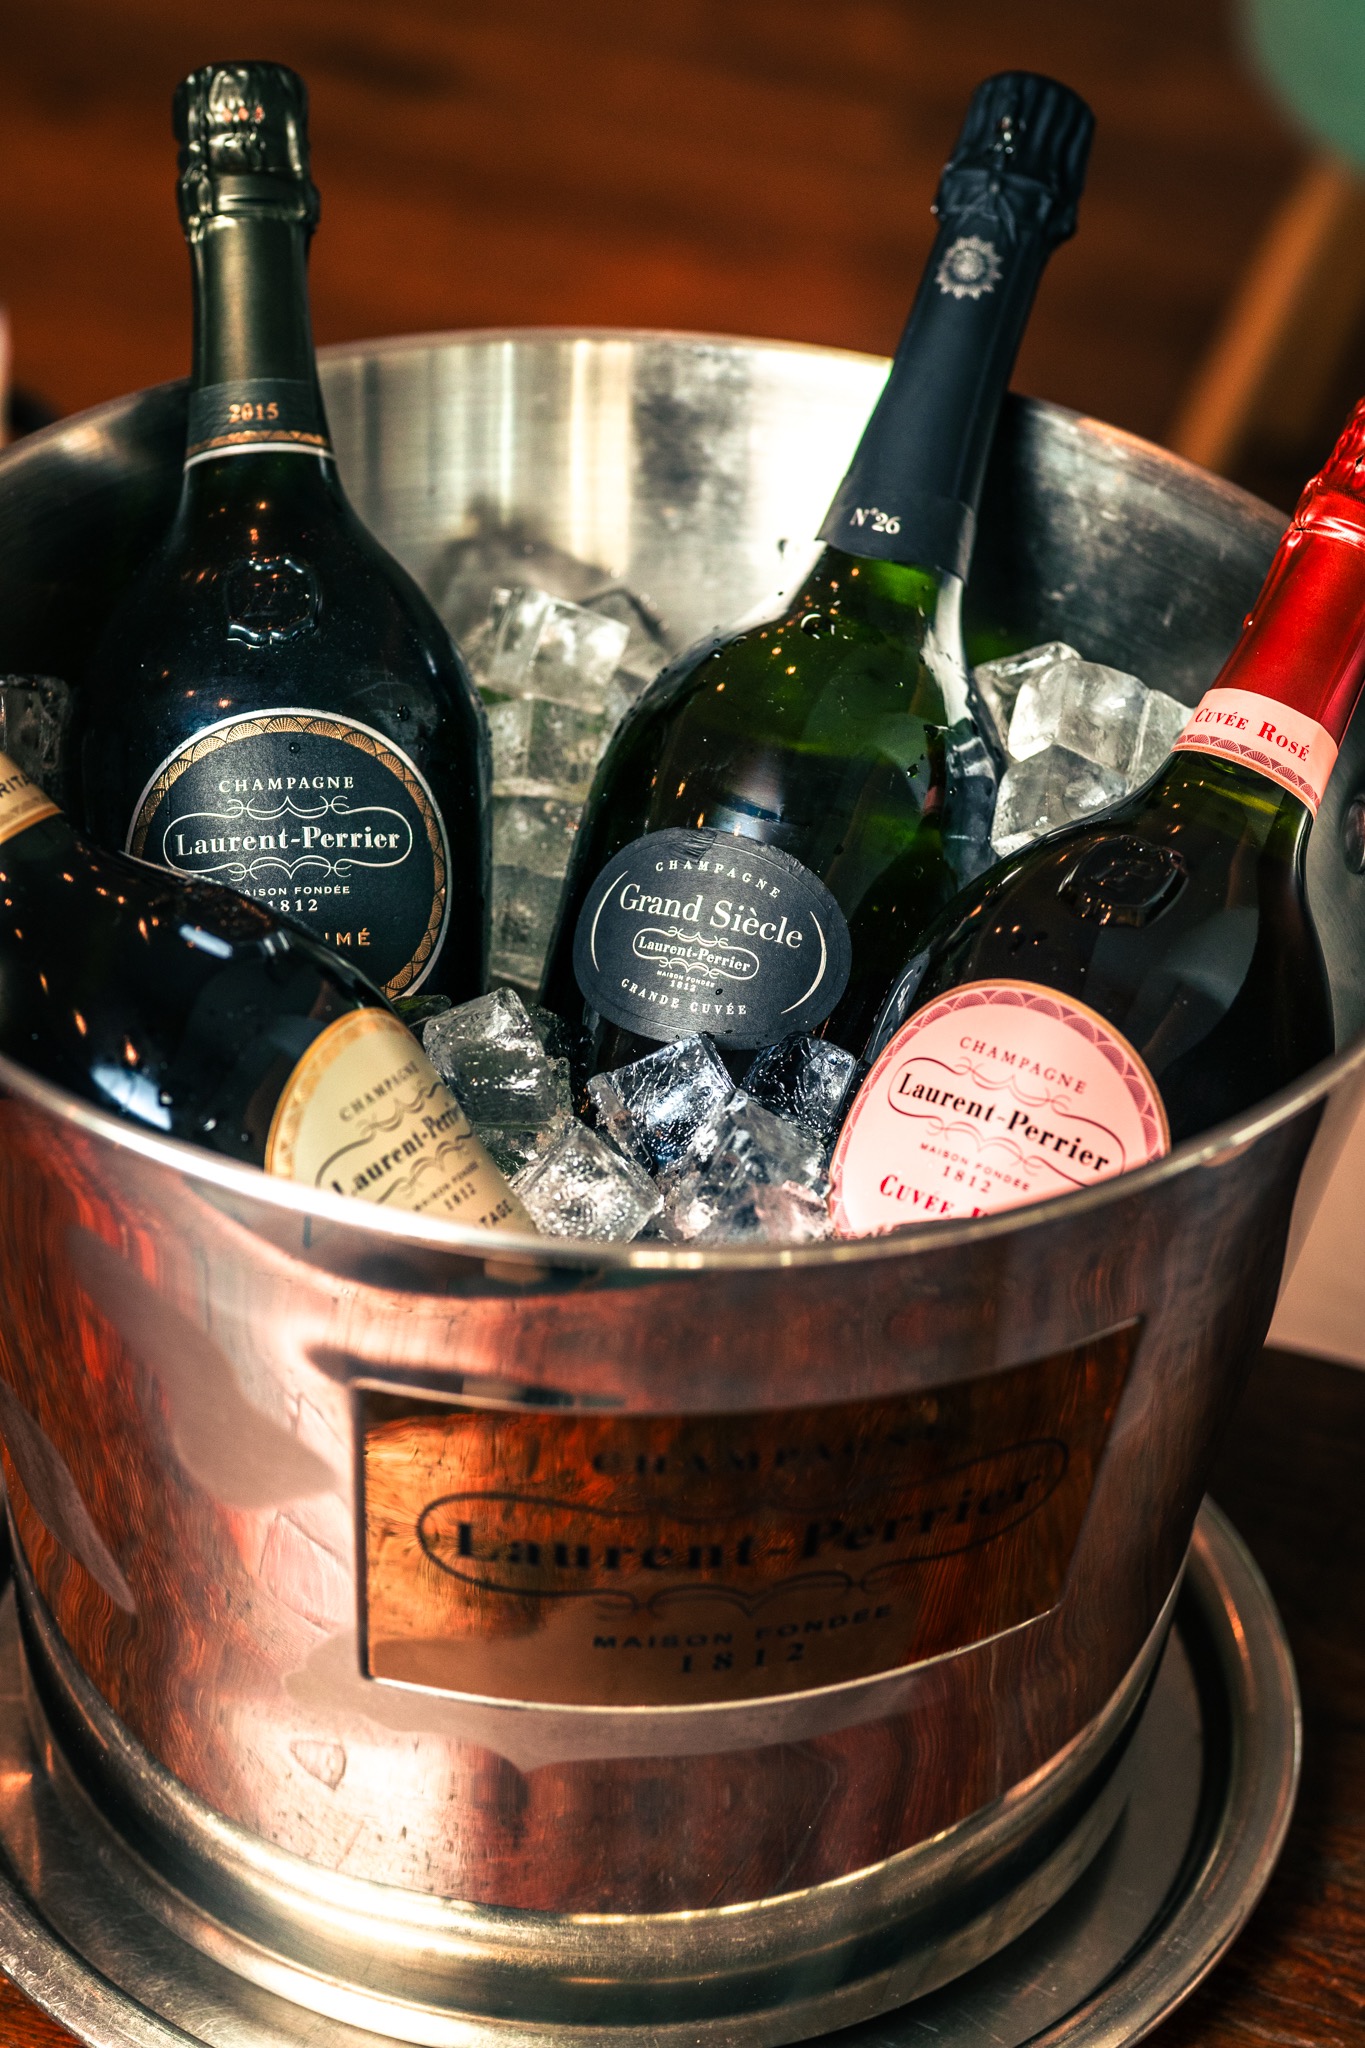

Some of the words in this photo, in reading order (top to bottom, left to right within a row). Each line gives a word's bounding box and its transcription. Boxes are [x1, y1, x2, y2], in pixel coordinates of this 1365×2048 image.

[228, 402, 280, 424] 2015
[1194, 708, 1249, 730] CUVÉE
[1256, 720, 1311, 762] ROSÉ
[218, 776, 355, 793] CHAMPAGNE
[175, 826, 401, 857] Laurent-Perrier
[238, 886, 288, 897] AISON
[294, 884, 351, 896] FONDÉE
[655, 860, 781, 898] CHAMPAGNE
[619, 882, 703, 923] Grand
[709, 899, 804, 949] Siècle
[637, 935, 752, 973] Laurent-Perrier
[656, 970, 684, 981] MAISON
[670, 979, 697, 993] 1812
[620, 977, 681, 1009] GRANDE
[689, 1001, 748, 1016] CUVÉE
[959, 1035, 1088, 1095] CHAMPAGNE
[896, 1072, 1111, 1173] Laurent-Perrier
[919, 1142, 969, 1166] MAISON
[942, 1165, 992, 1194] 1812
[455, 1470, 1045, 1572] Laurent-Perrier
[592, 1631, 733, 1651] MAISON
[680, 1641, 807, 1675] 1812
